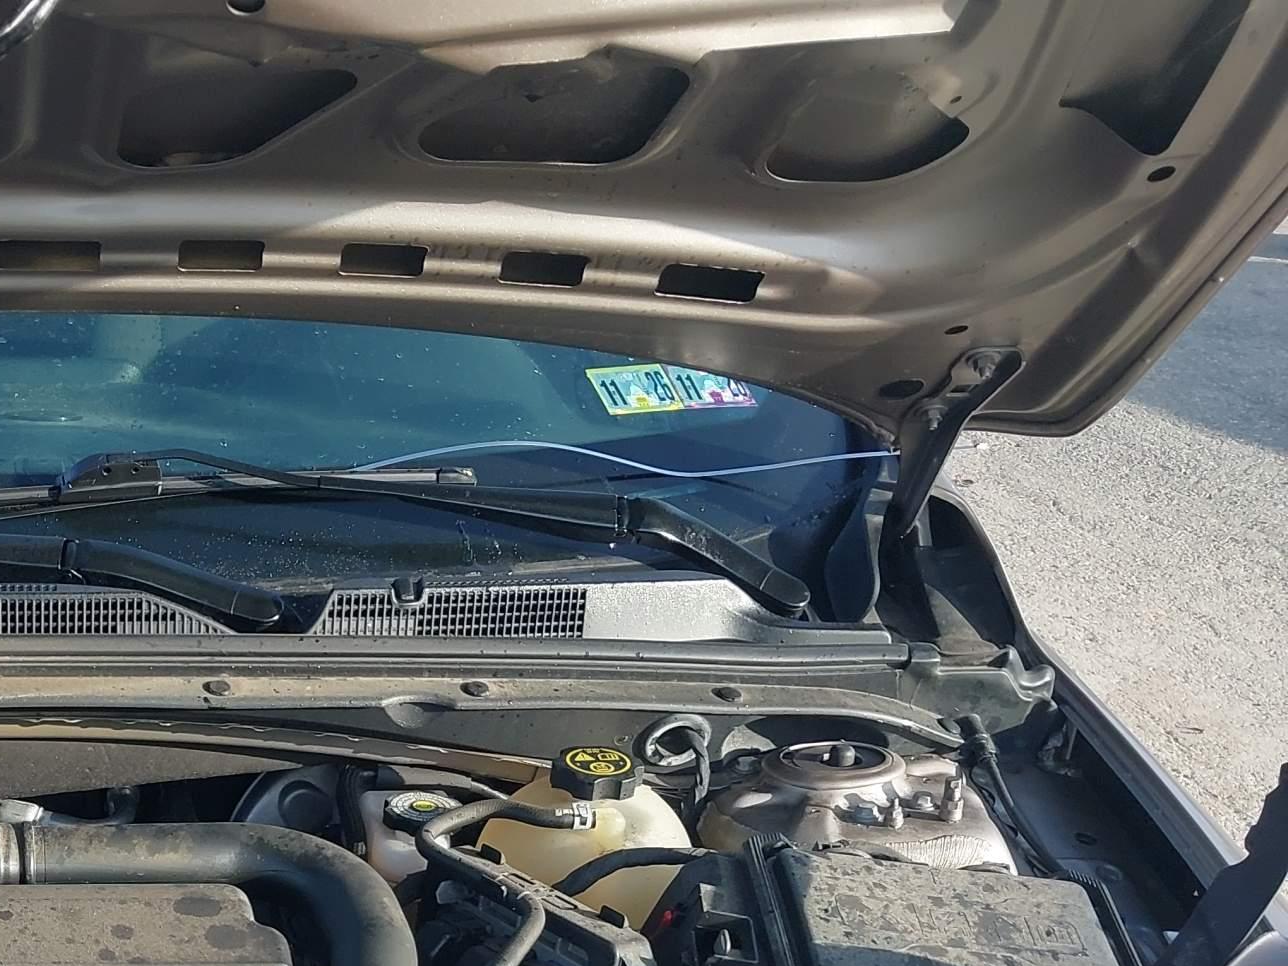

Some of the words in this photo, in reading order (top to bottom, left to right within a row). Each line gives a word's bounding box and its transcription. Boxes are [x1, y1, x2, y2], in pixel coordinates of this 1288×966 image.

[600, 379, 628, 406] 11
[644, 371, 675, 401] 26
[675, 374, 703, 400] 11
